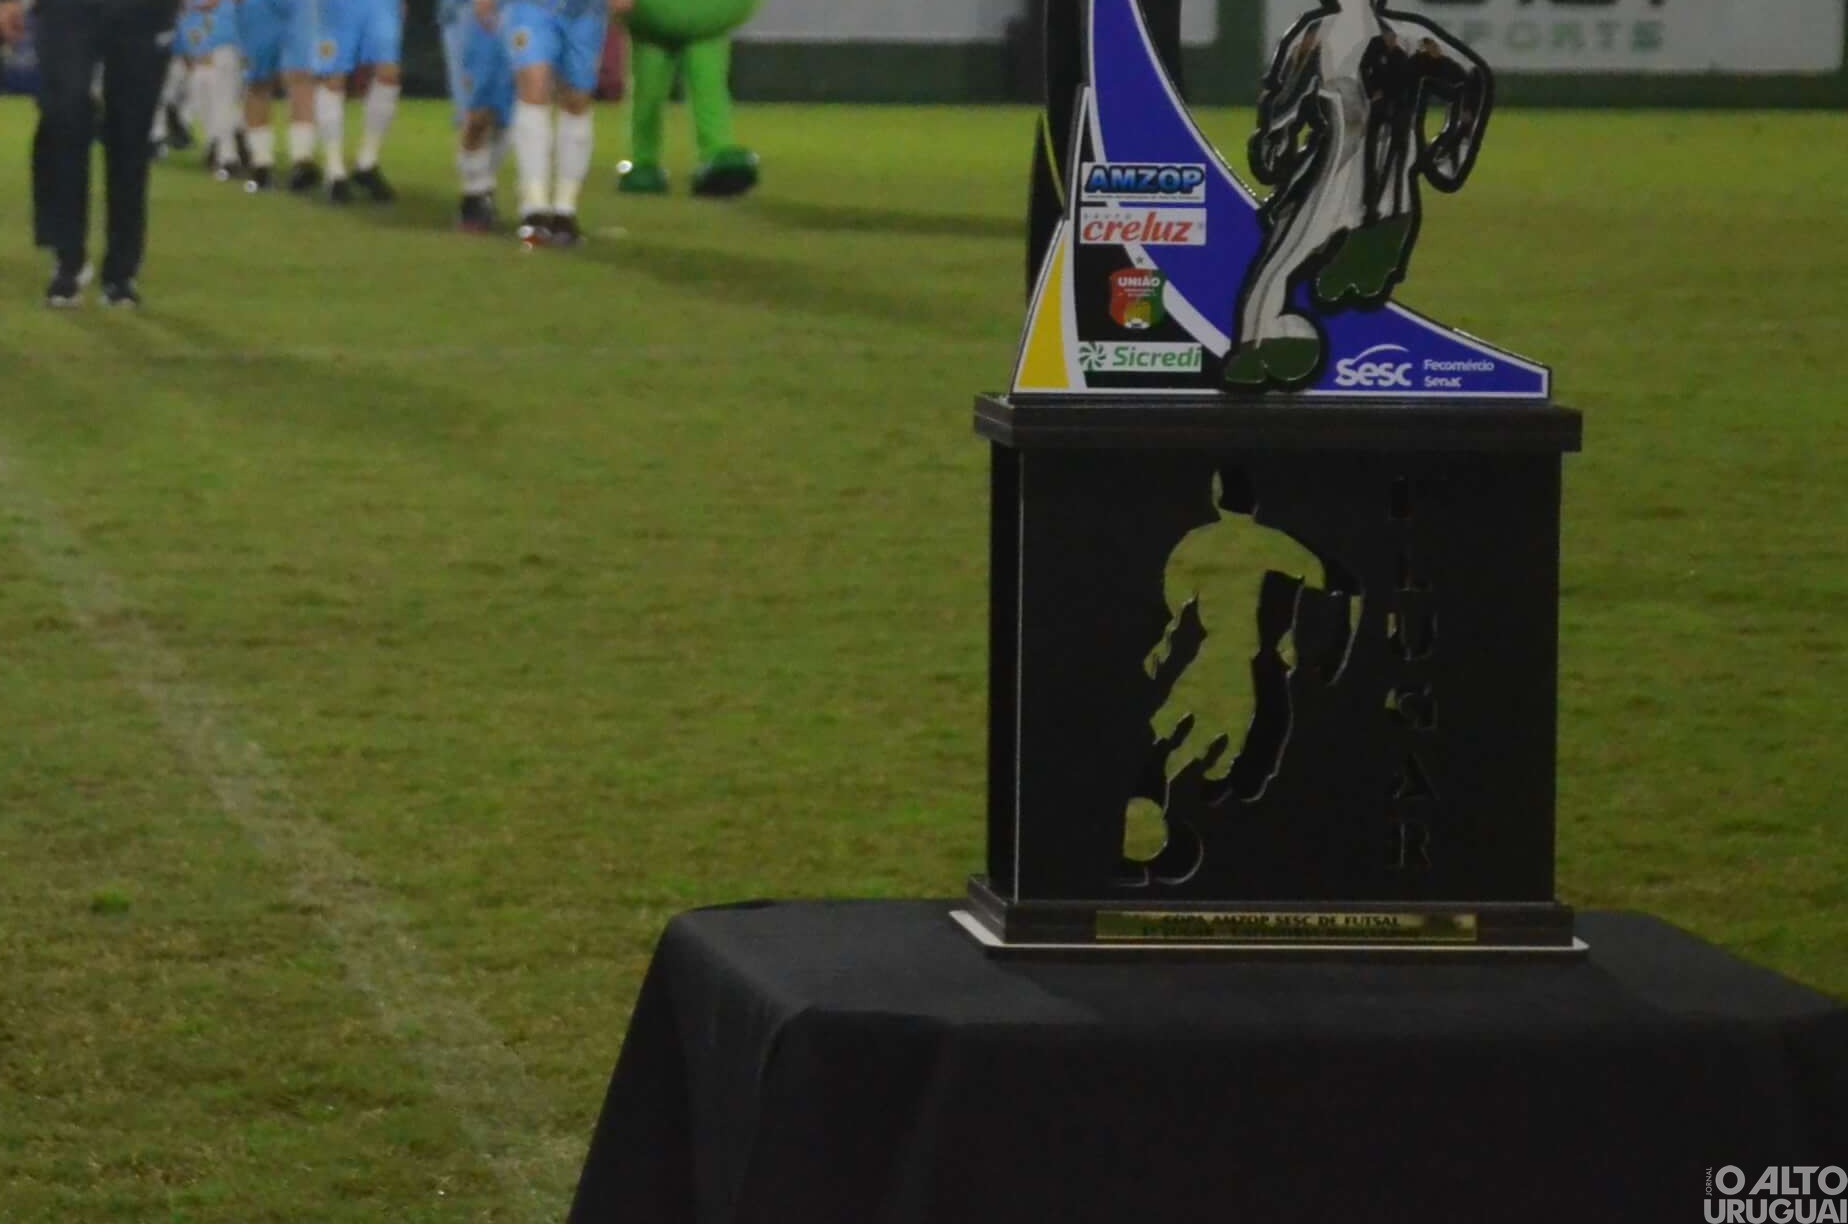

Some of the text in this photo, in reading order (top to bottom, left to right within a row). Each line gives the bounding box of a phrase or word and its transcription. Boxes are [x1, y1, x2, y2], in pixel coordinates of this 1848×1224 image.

[1466, 20, 1664, 52] PORTS
[1085, 163, 1206, 194] AMZOP
[1083, 211, 1193, 243] creluz
[1117, 275, 1161, 288] UNIÃO
[1112, 346, 1202, 367] Sicredi
[1423, 359, 1495, 372] Fecomércio
[1423, 376, 1462, 388] Senac
[1275, 915, 1313, 926] SESC
[1318, 916, 1337, 926] DE
[1344, 916, 1400, 927] FUTSAL
